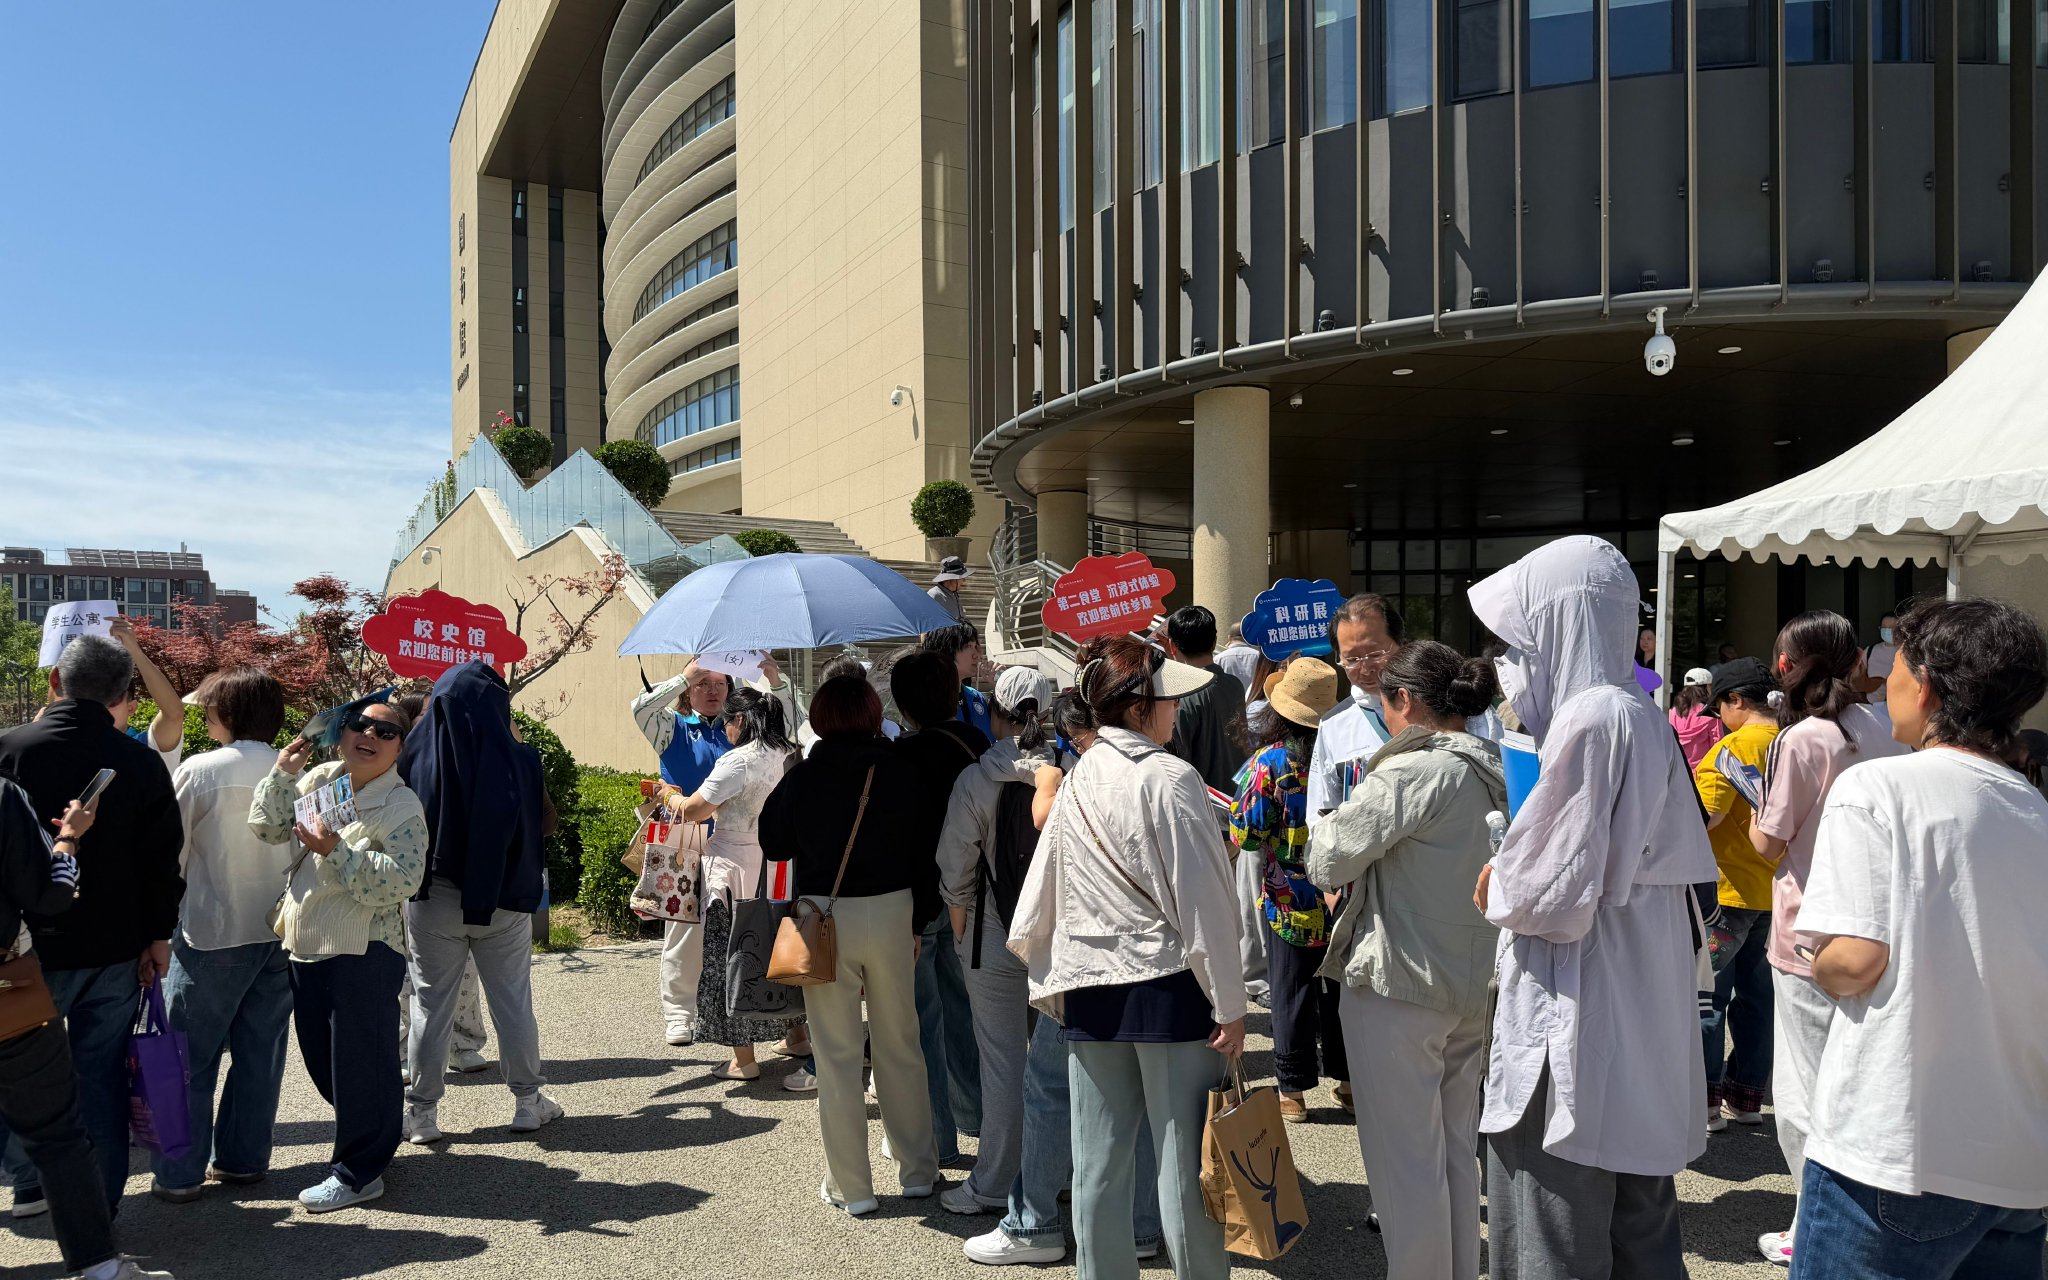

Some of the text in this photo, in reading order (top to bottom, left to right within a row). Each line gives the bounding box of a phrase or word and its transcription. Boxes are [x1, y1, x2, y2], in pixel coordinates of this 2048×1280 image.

[1057, 588, 1102, 612] 第二食堂
[1106, 573, 1161, 599] 沉浸式体验
[51, 612, 101, 629] 学生公寓
[1076, 595, 1152, 627] 欢迎您前往参观
[1274, 602, 1328, 624] 科研展
[413, 617, 486, 648] 校史馆
[1267, 622, 1331, 644] 欢迎您前往参
